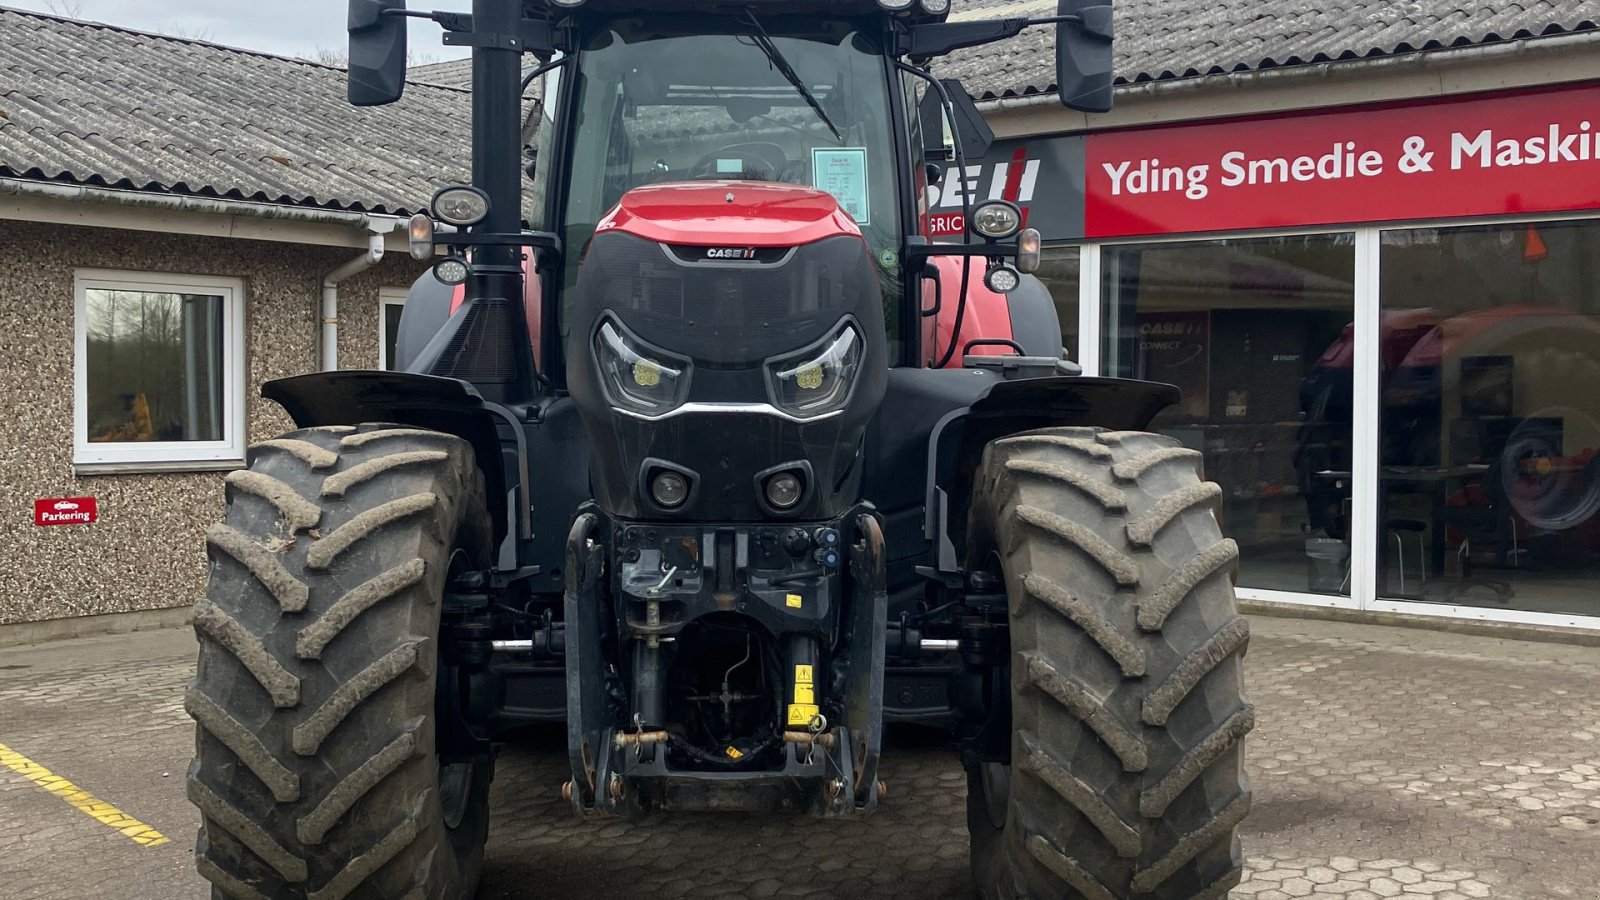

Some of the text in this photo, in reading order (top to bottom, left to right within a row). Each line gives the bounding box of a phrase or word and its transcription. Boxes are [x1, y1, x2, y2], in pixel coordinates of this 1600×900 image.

[1102, 121, 1600, 200] Yding Smedie & Maski
[930, 216, 965, 233] GRIC
[707, 248, 742, 258] CASE
[1140, 322, 1185, 334] CASE
[1139, 341, 1182, 350] CONNECT
[42, 511, 90, 521] Parkering
